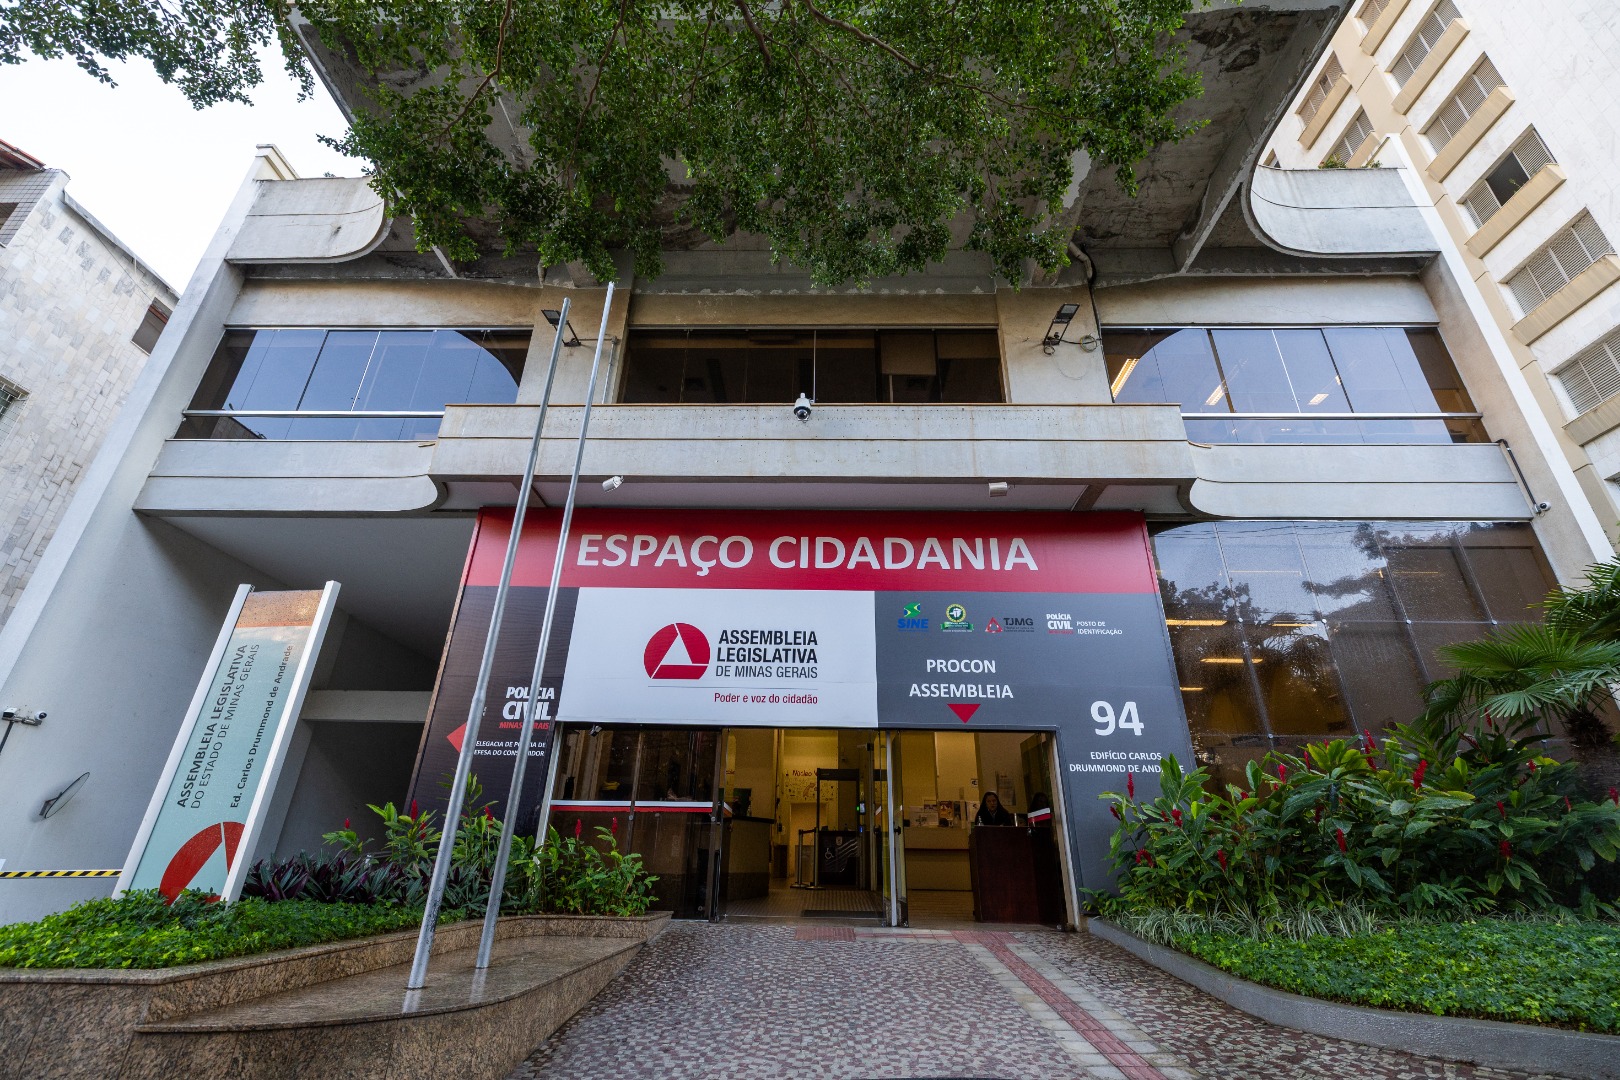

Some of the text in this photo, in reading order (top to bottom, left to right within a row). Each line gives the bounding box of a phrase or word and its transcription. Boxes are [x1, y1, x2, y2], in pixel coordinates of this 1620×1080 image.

[576, 534, 1039, 576] ESPAÇO CIDADANIA
[897, 618, 929, 629] SINE
[1003, 617, 1034, 626] TJMG
[1047, 620, 1073, 630] CIVIL
[718, 629, 818, 646] ASSEMBLEIA
[716, 647, 818, 664] LEGISLATIVA
[715, 665, 818, 679] DE MINAS GERAIS
[926, 659, 996, 674] PROCON
[714, 692, 818, 704] Poder e voz do cidadão
[908, 683, 1014, 699] ASSEMBLEIA
[1089, 700, 1145, 736] 94
[177, 644, 248, 808] ASSEMBLEIA LEGISLATIVA
[191, 644, 260, 809] DO ESTADO DE MINAS GERAIS
[230, 645, 293, 808] Ed. Carlos Drummond de Andrade
[474, 740, 504, 748] ELEGACIA
[1090, 750, 1162, 761] EDIFÍCIO CARLOS
[1069, 763, 1185, 773] DRUMMOND DE ANDE
